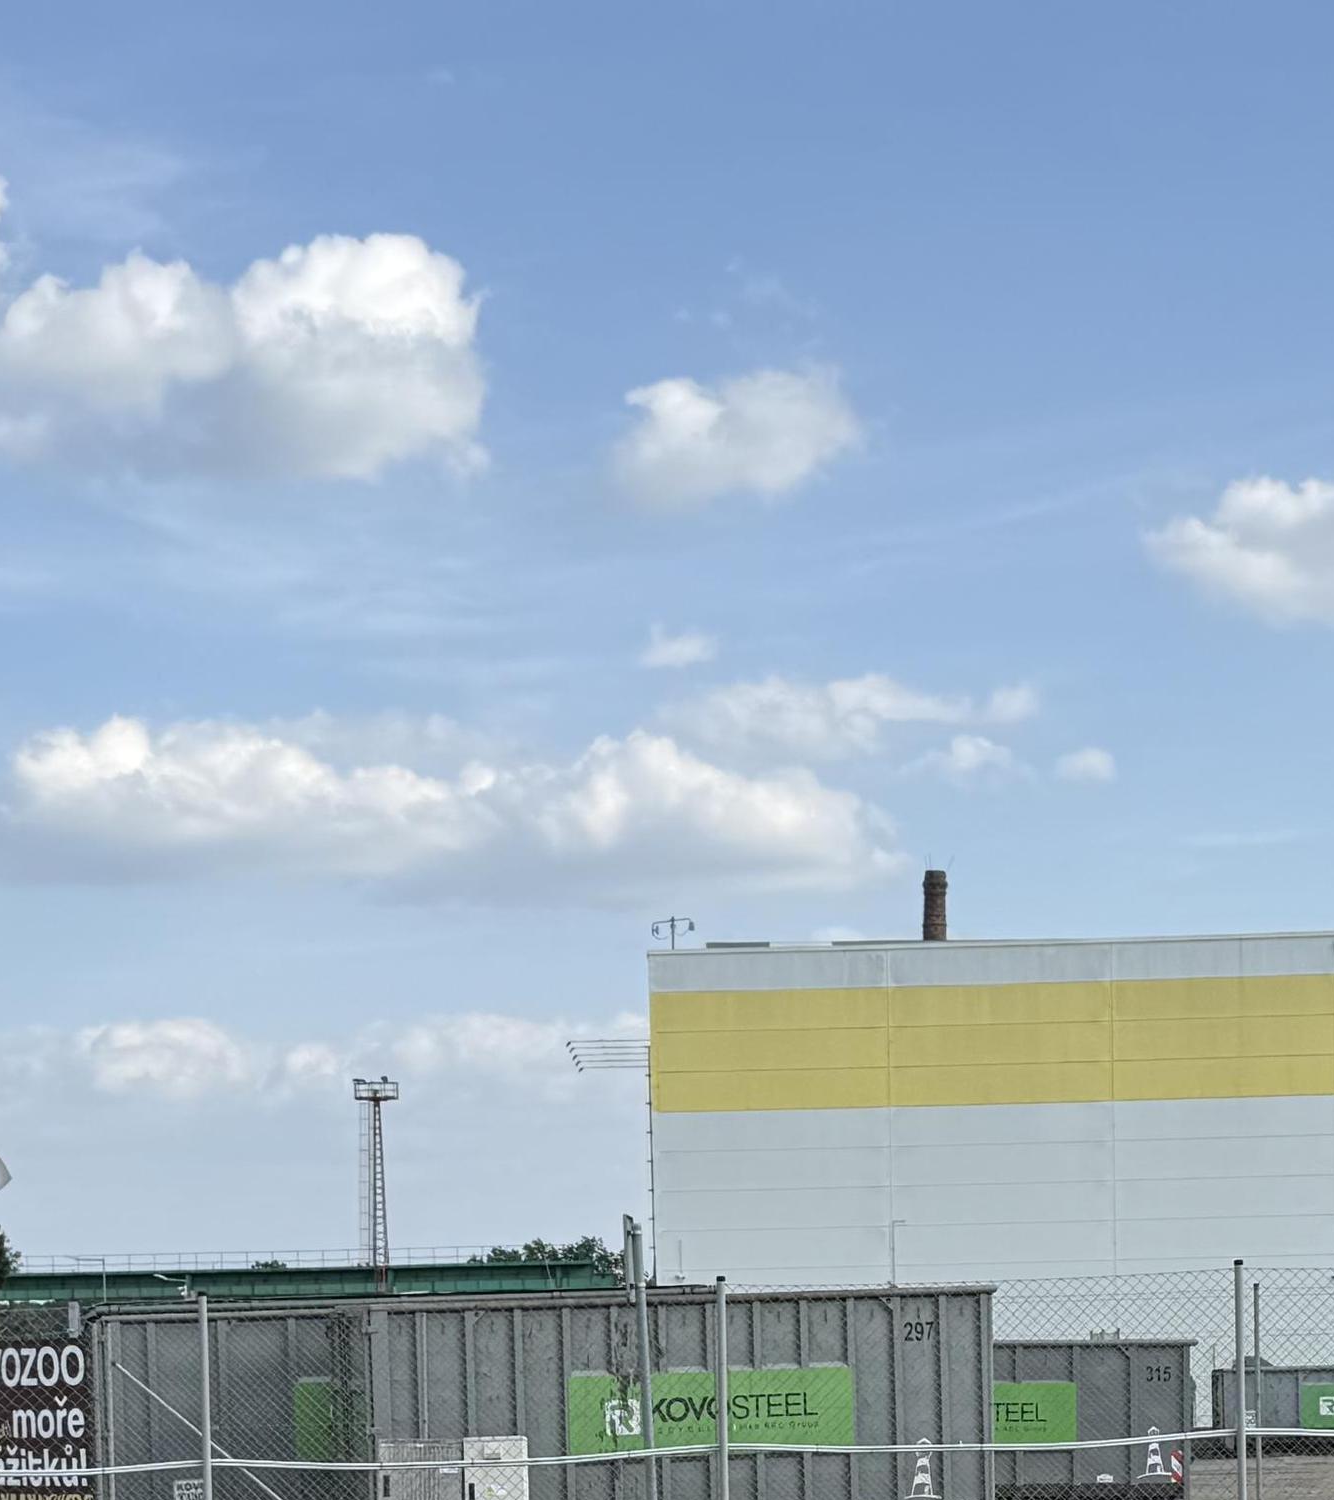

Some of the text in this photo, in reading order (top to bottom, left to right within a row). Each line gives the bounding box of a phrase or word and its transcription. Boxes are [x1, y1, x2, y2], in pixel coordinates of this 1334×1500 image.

[903, 1321, 934, 1341] 297
[1146, 1366, 1172, 1382] 315
[12, 1395, 86, 1439] moře
